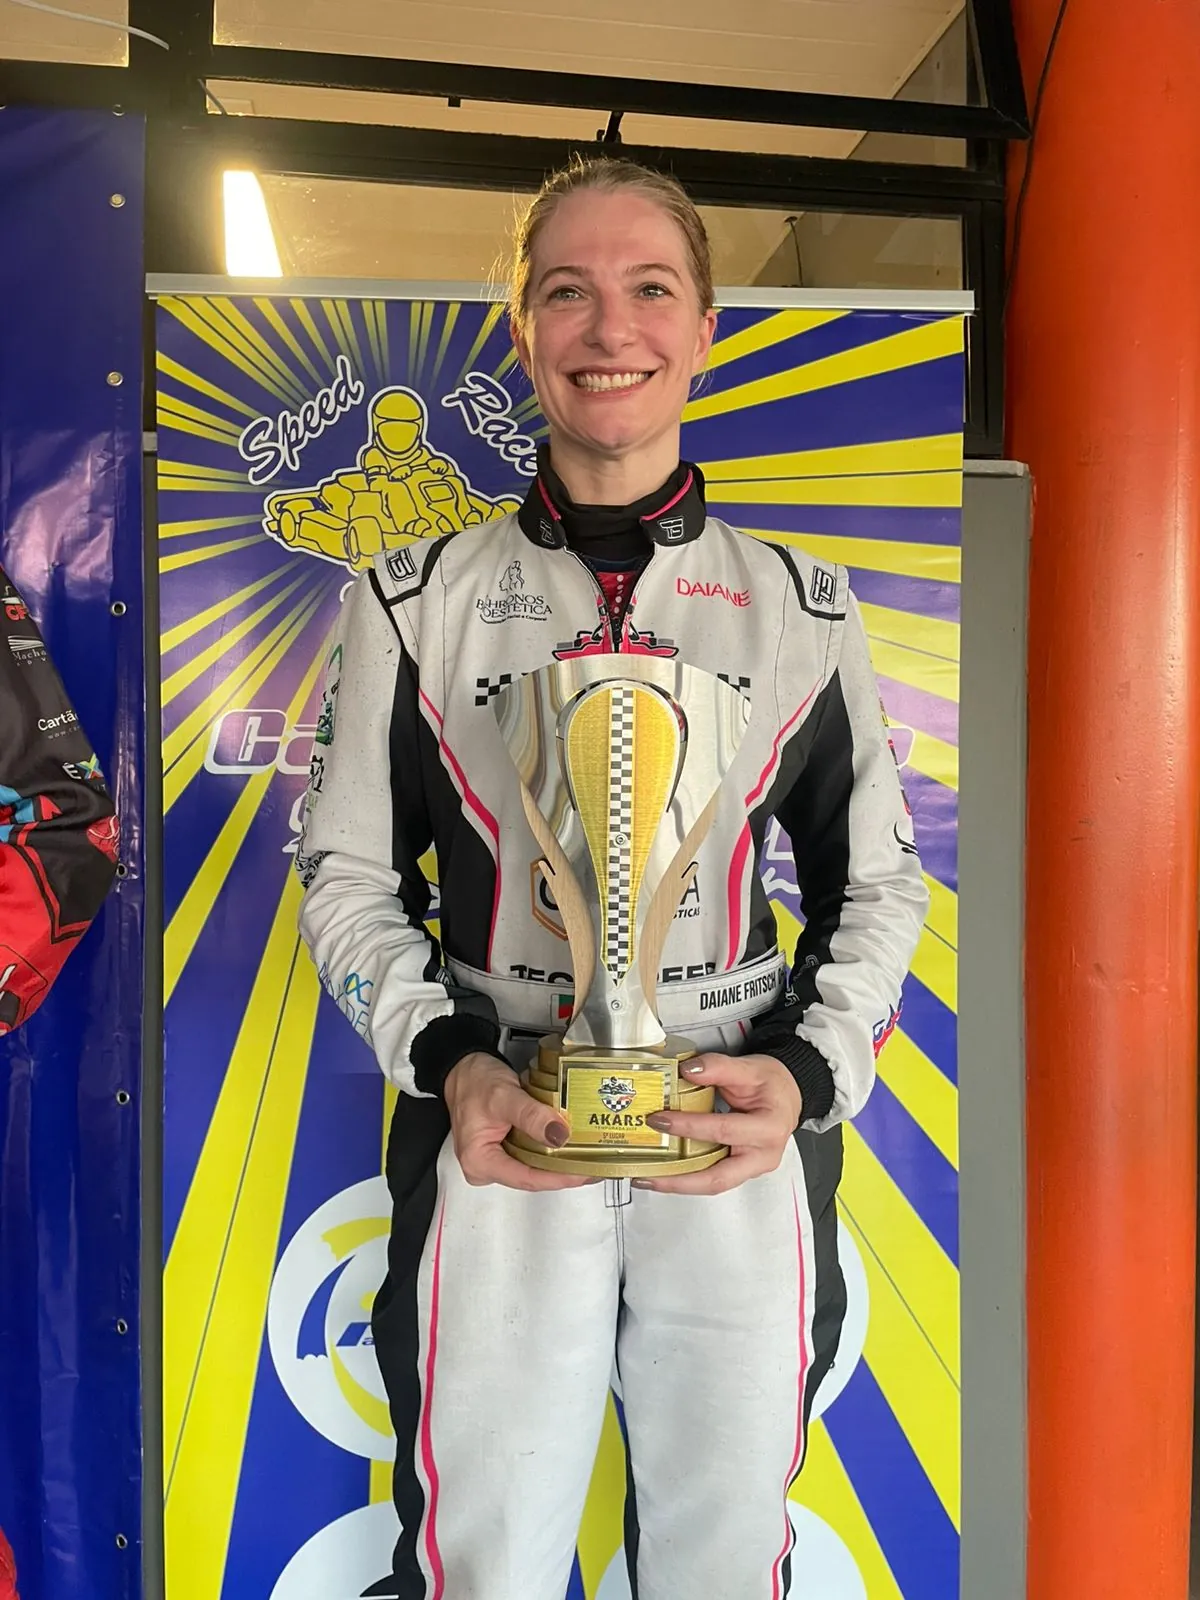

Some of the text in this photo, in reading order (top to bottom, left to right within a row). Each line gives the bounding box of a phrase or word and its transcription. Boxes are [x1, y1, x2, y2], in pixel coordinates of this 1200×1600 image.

[239, 355, 364, 485] Speed
[441, 371, 538, 477] Race
[677, 577, 751, 607] DAIANE
[700, 984, 742, 1011] DAIANE
[744, 971, 777, 1000] FRITSCH
[589, 1113, 644, 1127] AKARS
